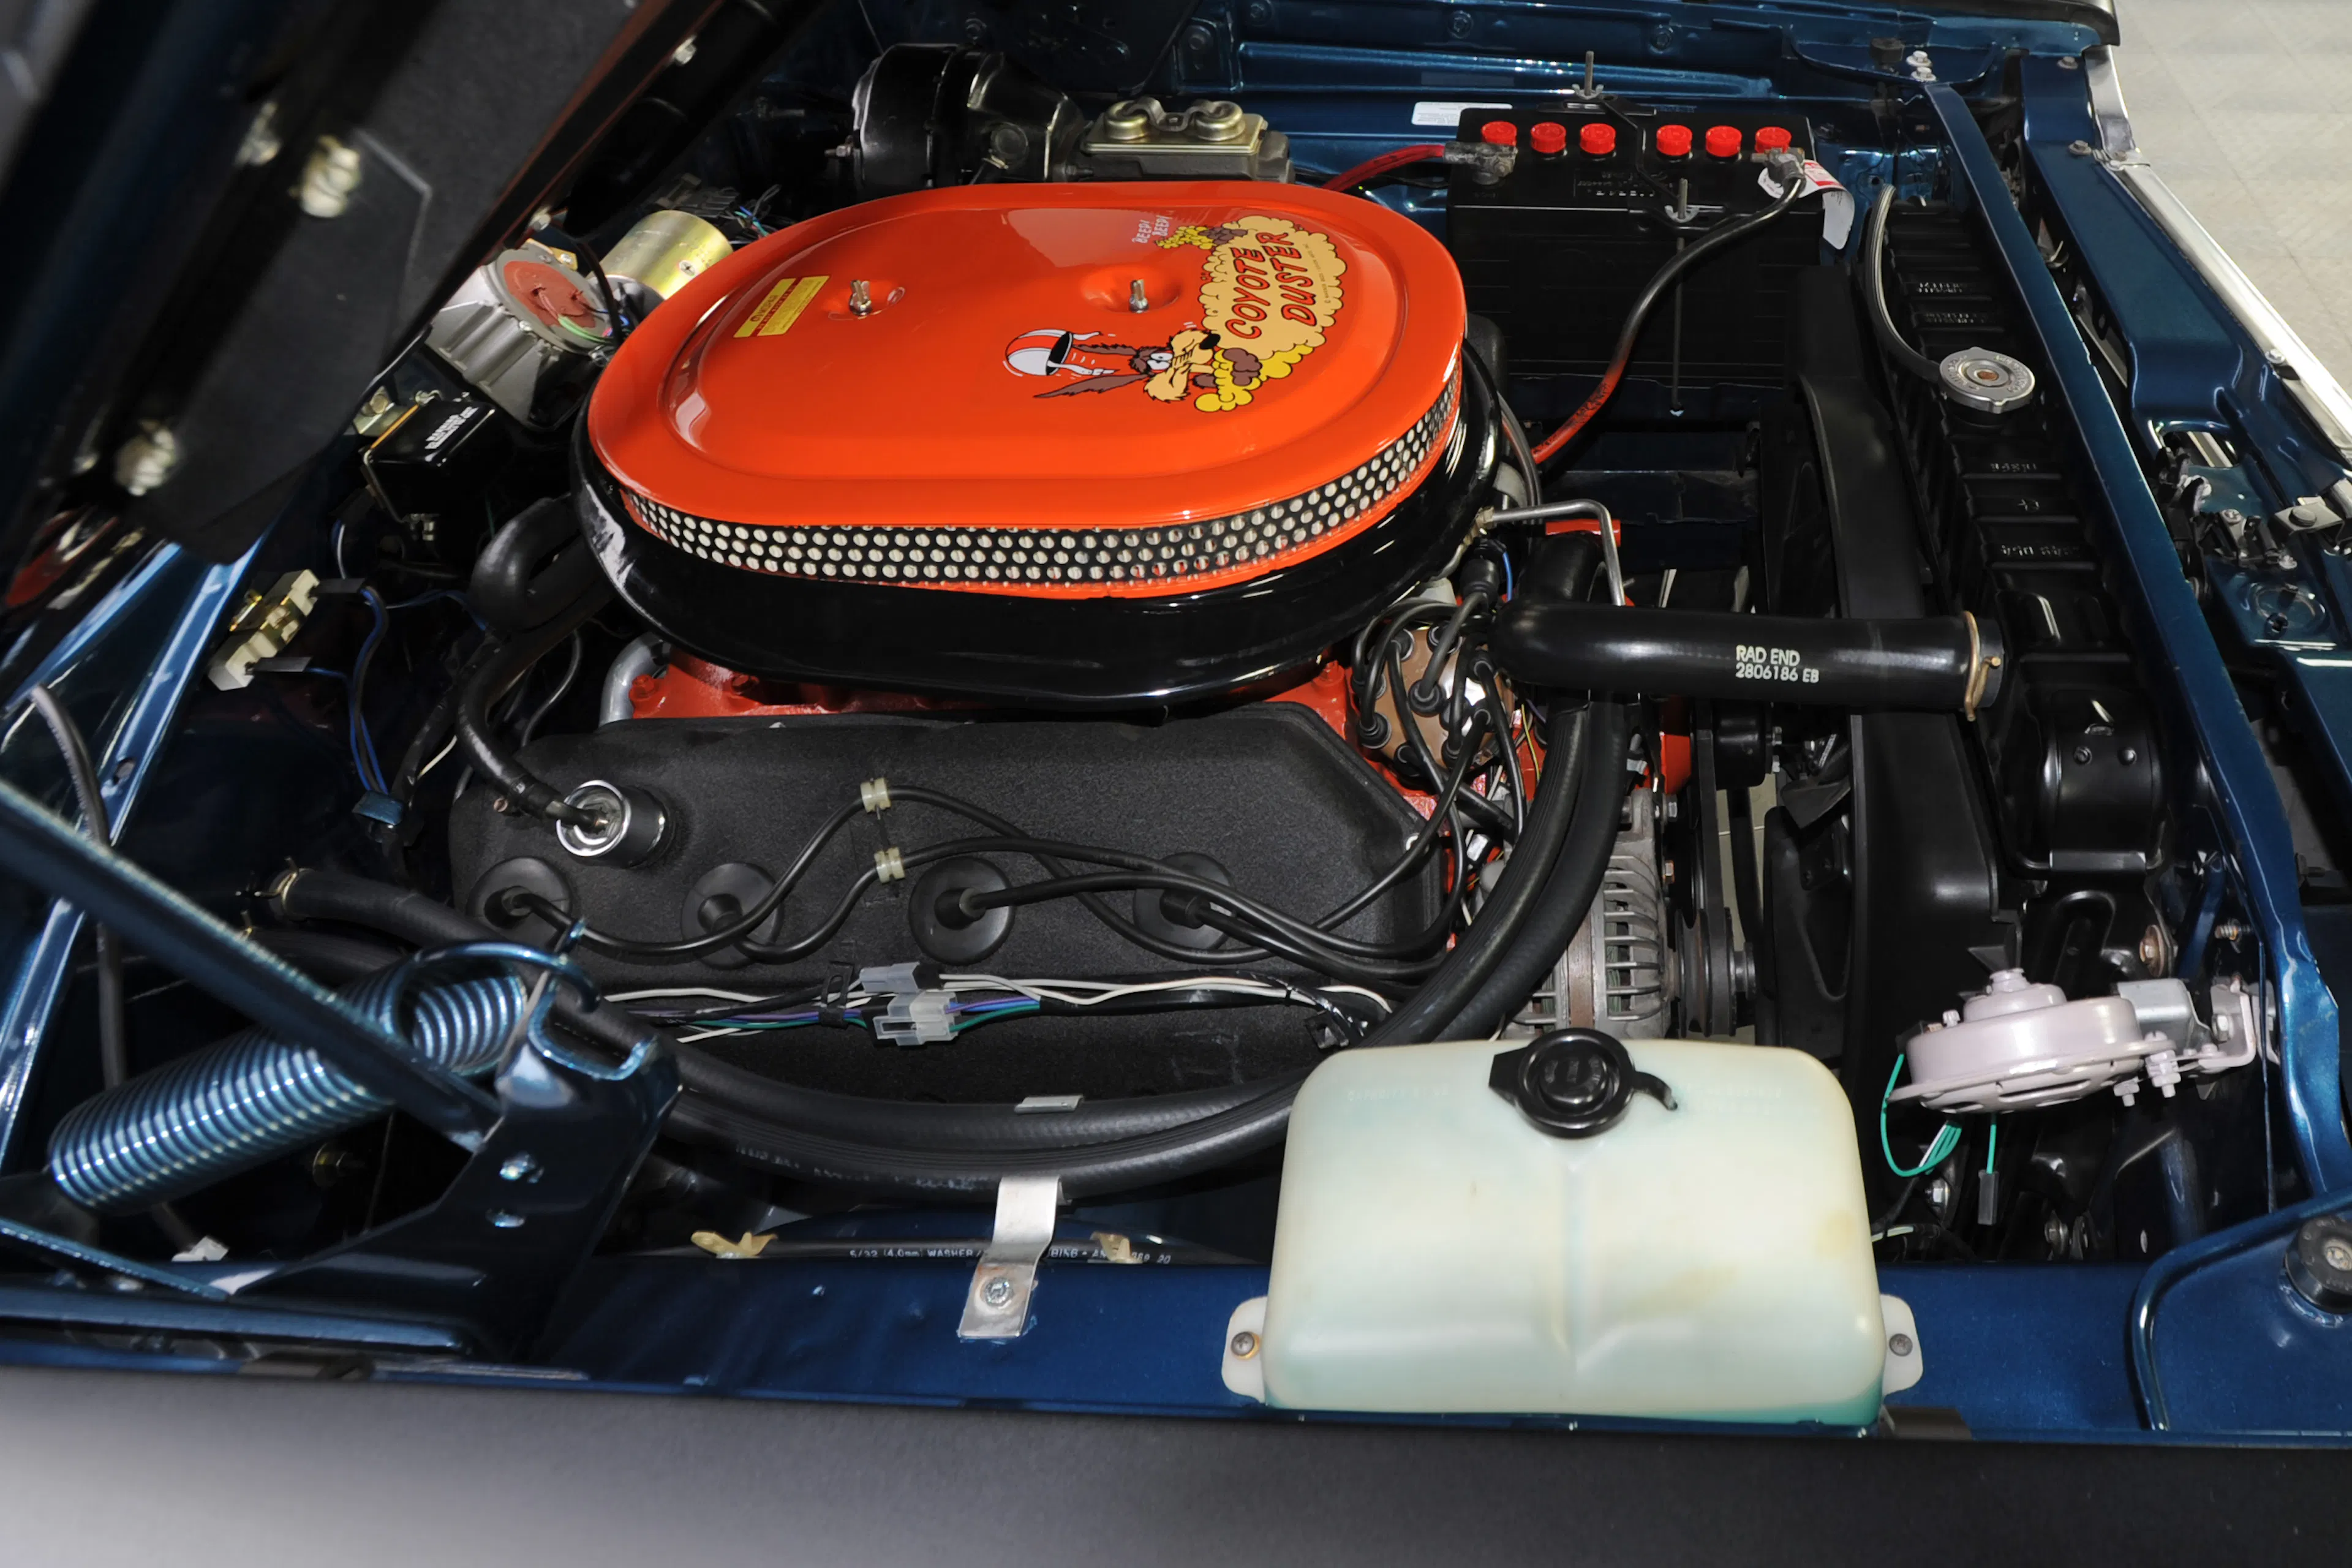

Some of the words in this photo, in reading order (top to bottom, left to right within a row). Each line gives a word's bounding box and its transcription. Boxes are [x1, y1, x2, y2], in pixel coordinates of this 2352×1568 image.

[1225, 247, 1271, 339] COYOTE
[1256, 232, 1317, 326] DUSTER
[1735, 663, 1798, 682] 2806186
[1803, 668, 1819, 684] EB
[1736, 645, 1766, 662] RAD
[1771, 649, 1800, 666] END
